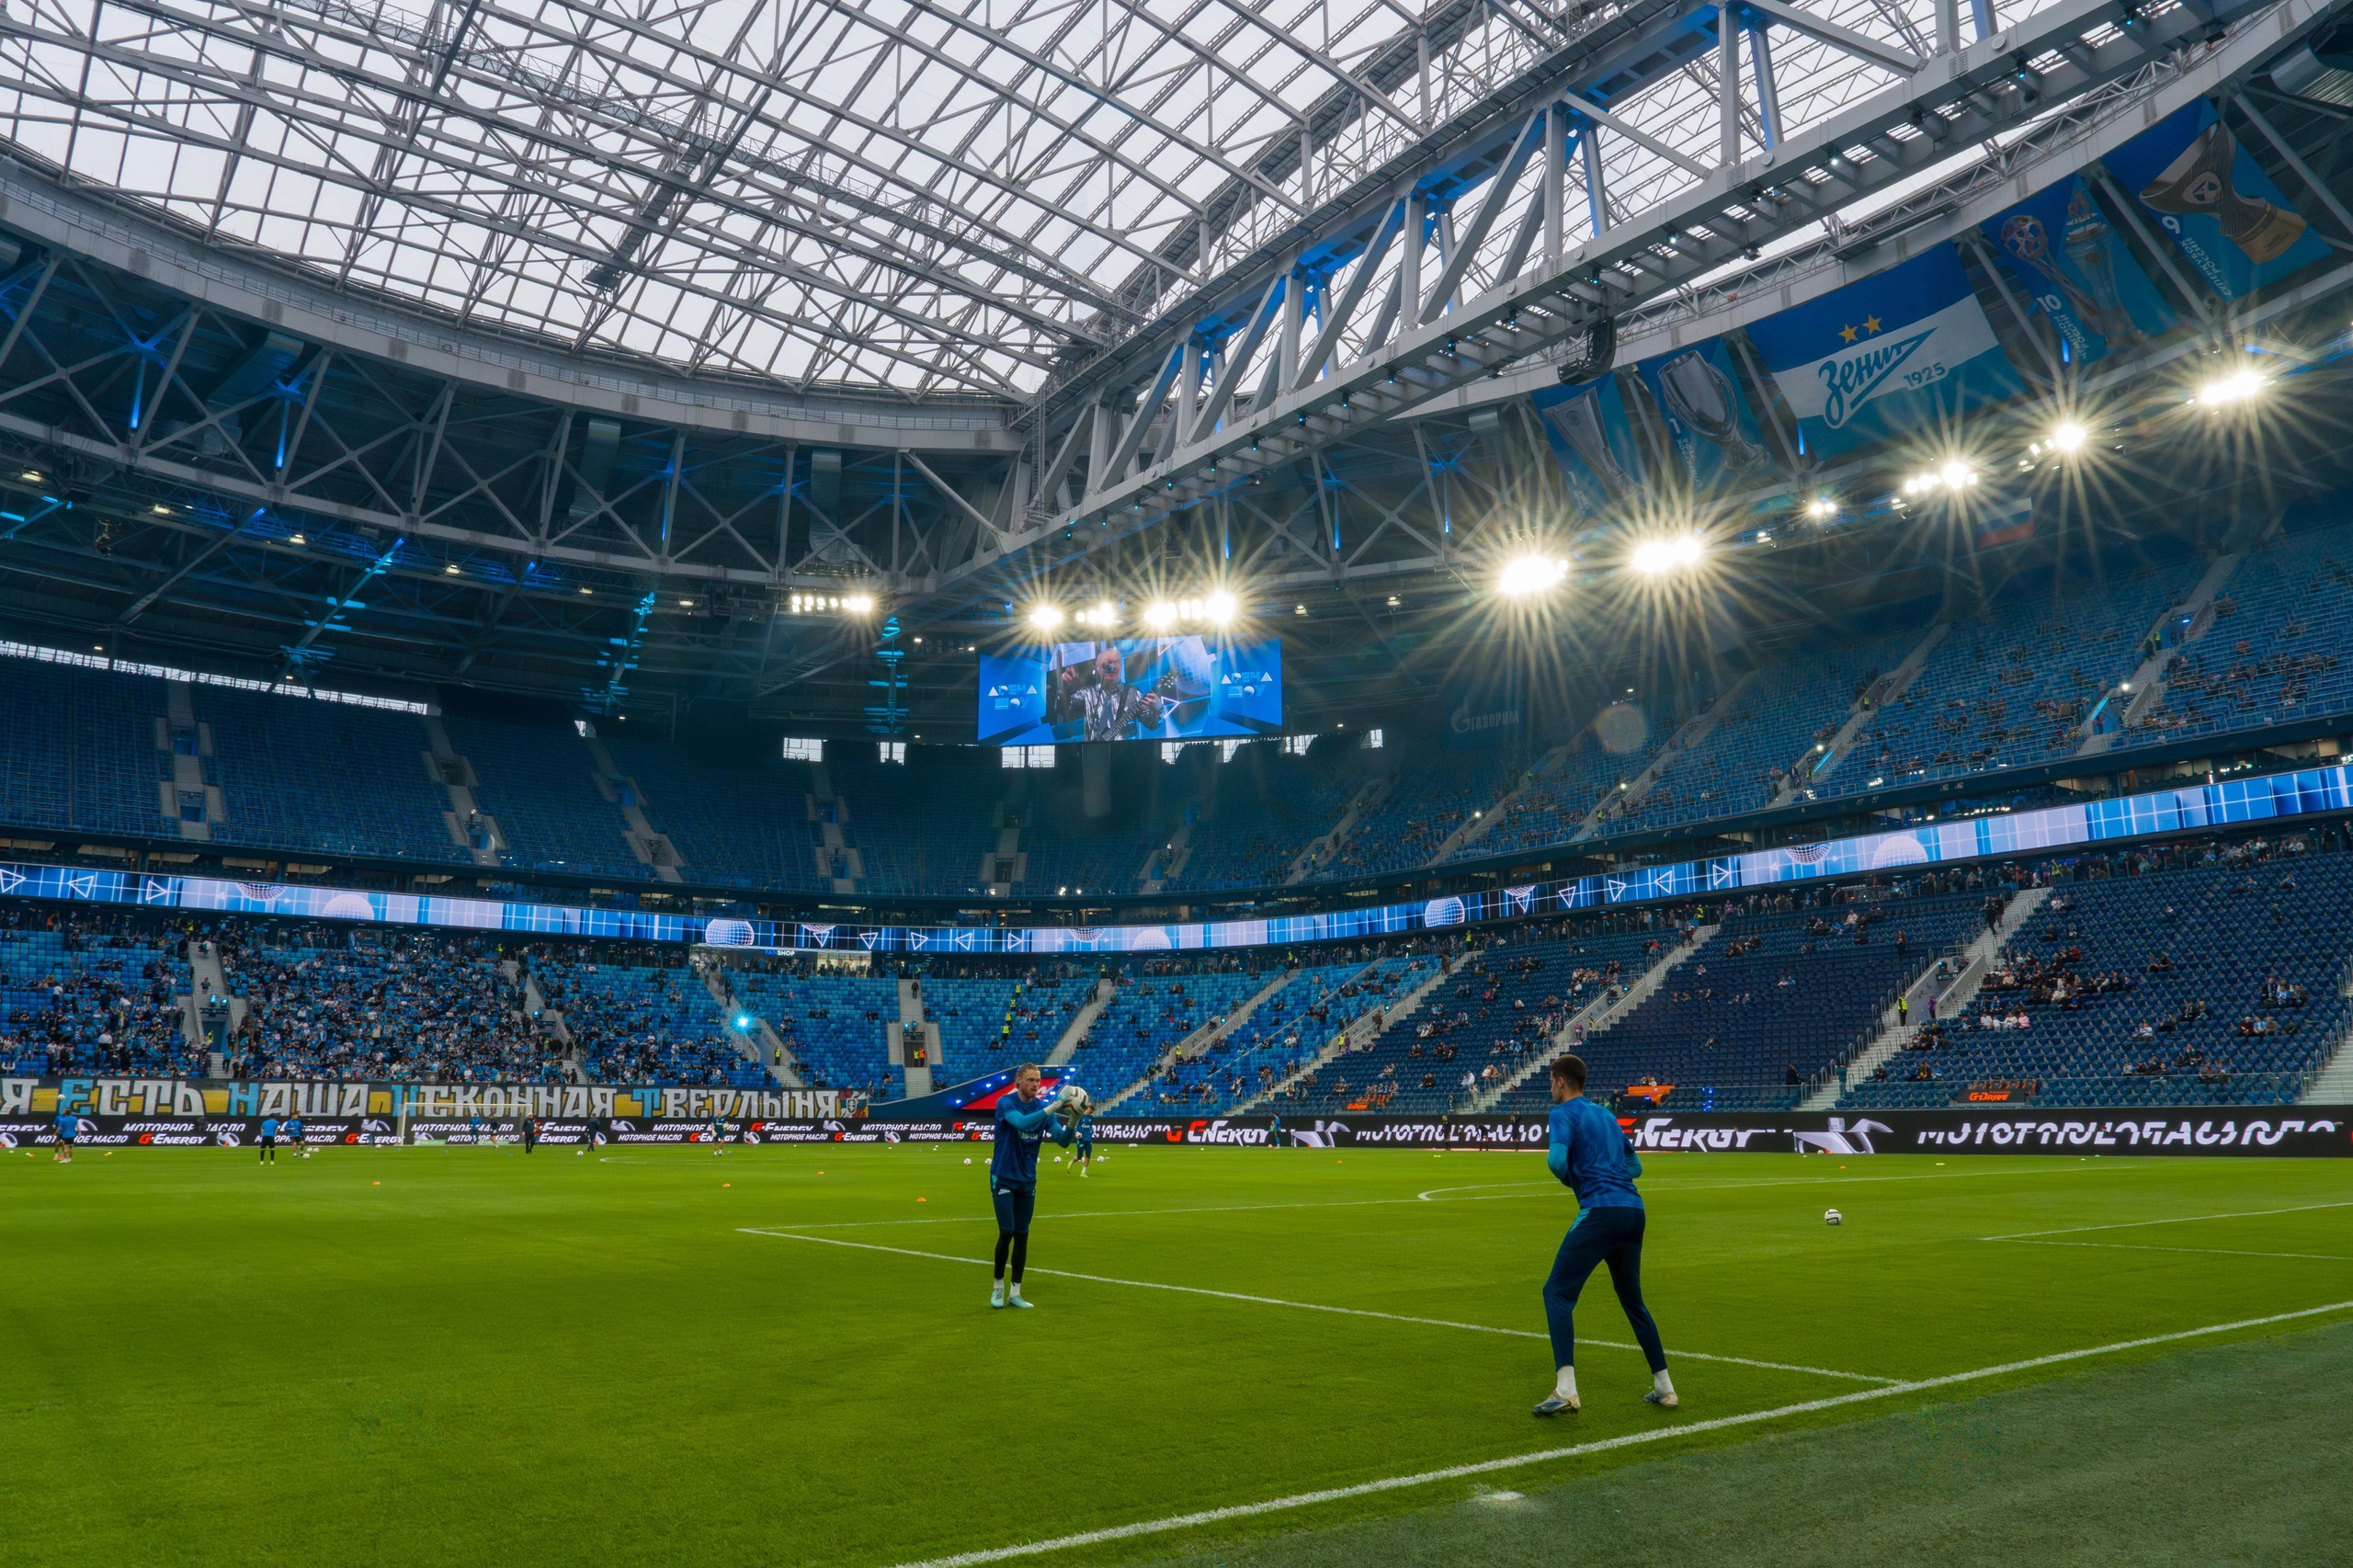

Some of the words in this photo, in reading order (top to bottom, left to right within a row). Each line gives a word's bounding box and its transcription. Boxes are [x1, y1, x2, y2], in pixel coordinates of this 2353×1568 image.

[2162, 216, 2180, 234] 9
[2036, 294, 2062, 312] 10
[1903, 362, 1946, 388] 1925
[59, 1079, 204, 1116] ЕСТЬ
[228, 1083, 369, 1117] НАША
[391, 1085, 617, 1118] ИСКОННАЯ
[92, 1135, 128, 1143] МАСЛО
